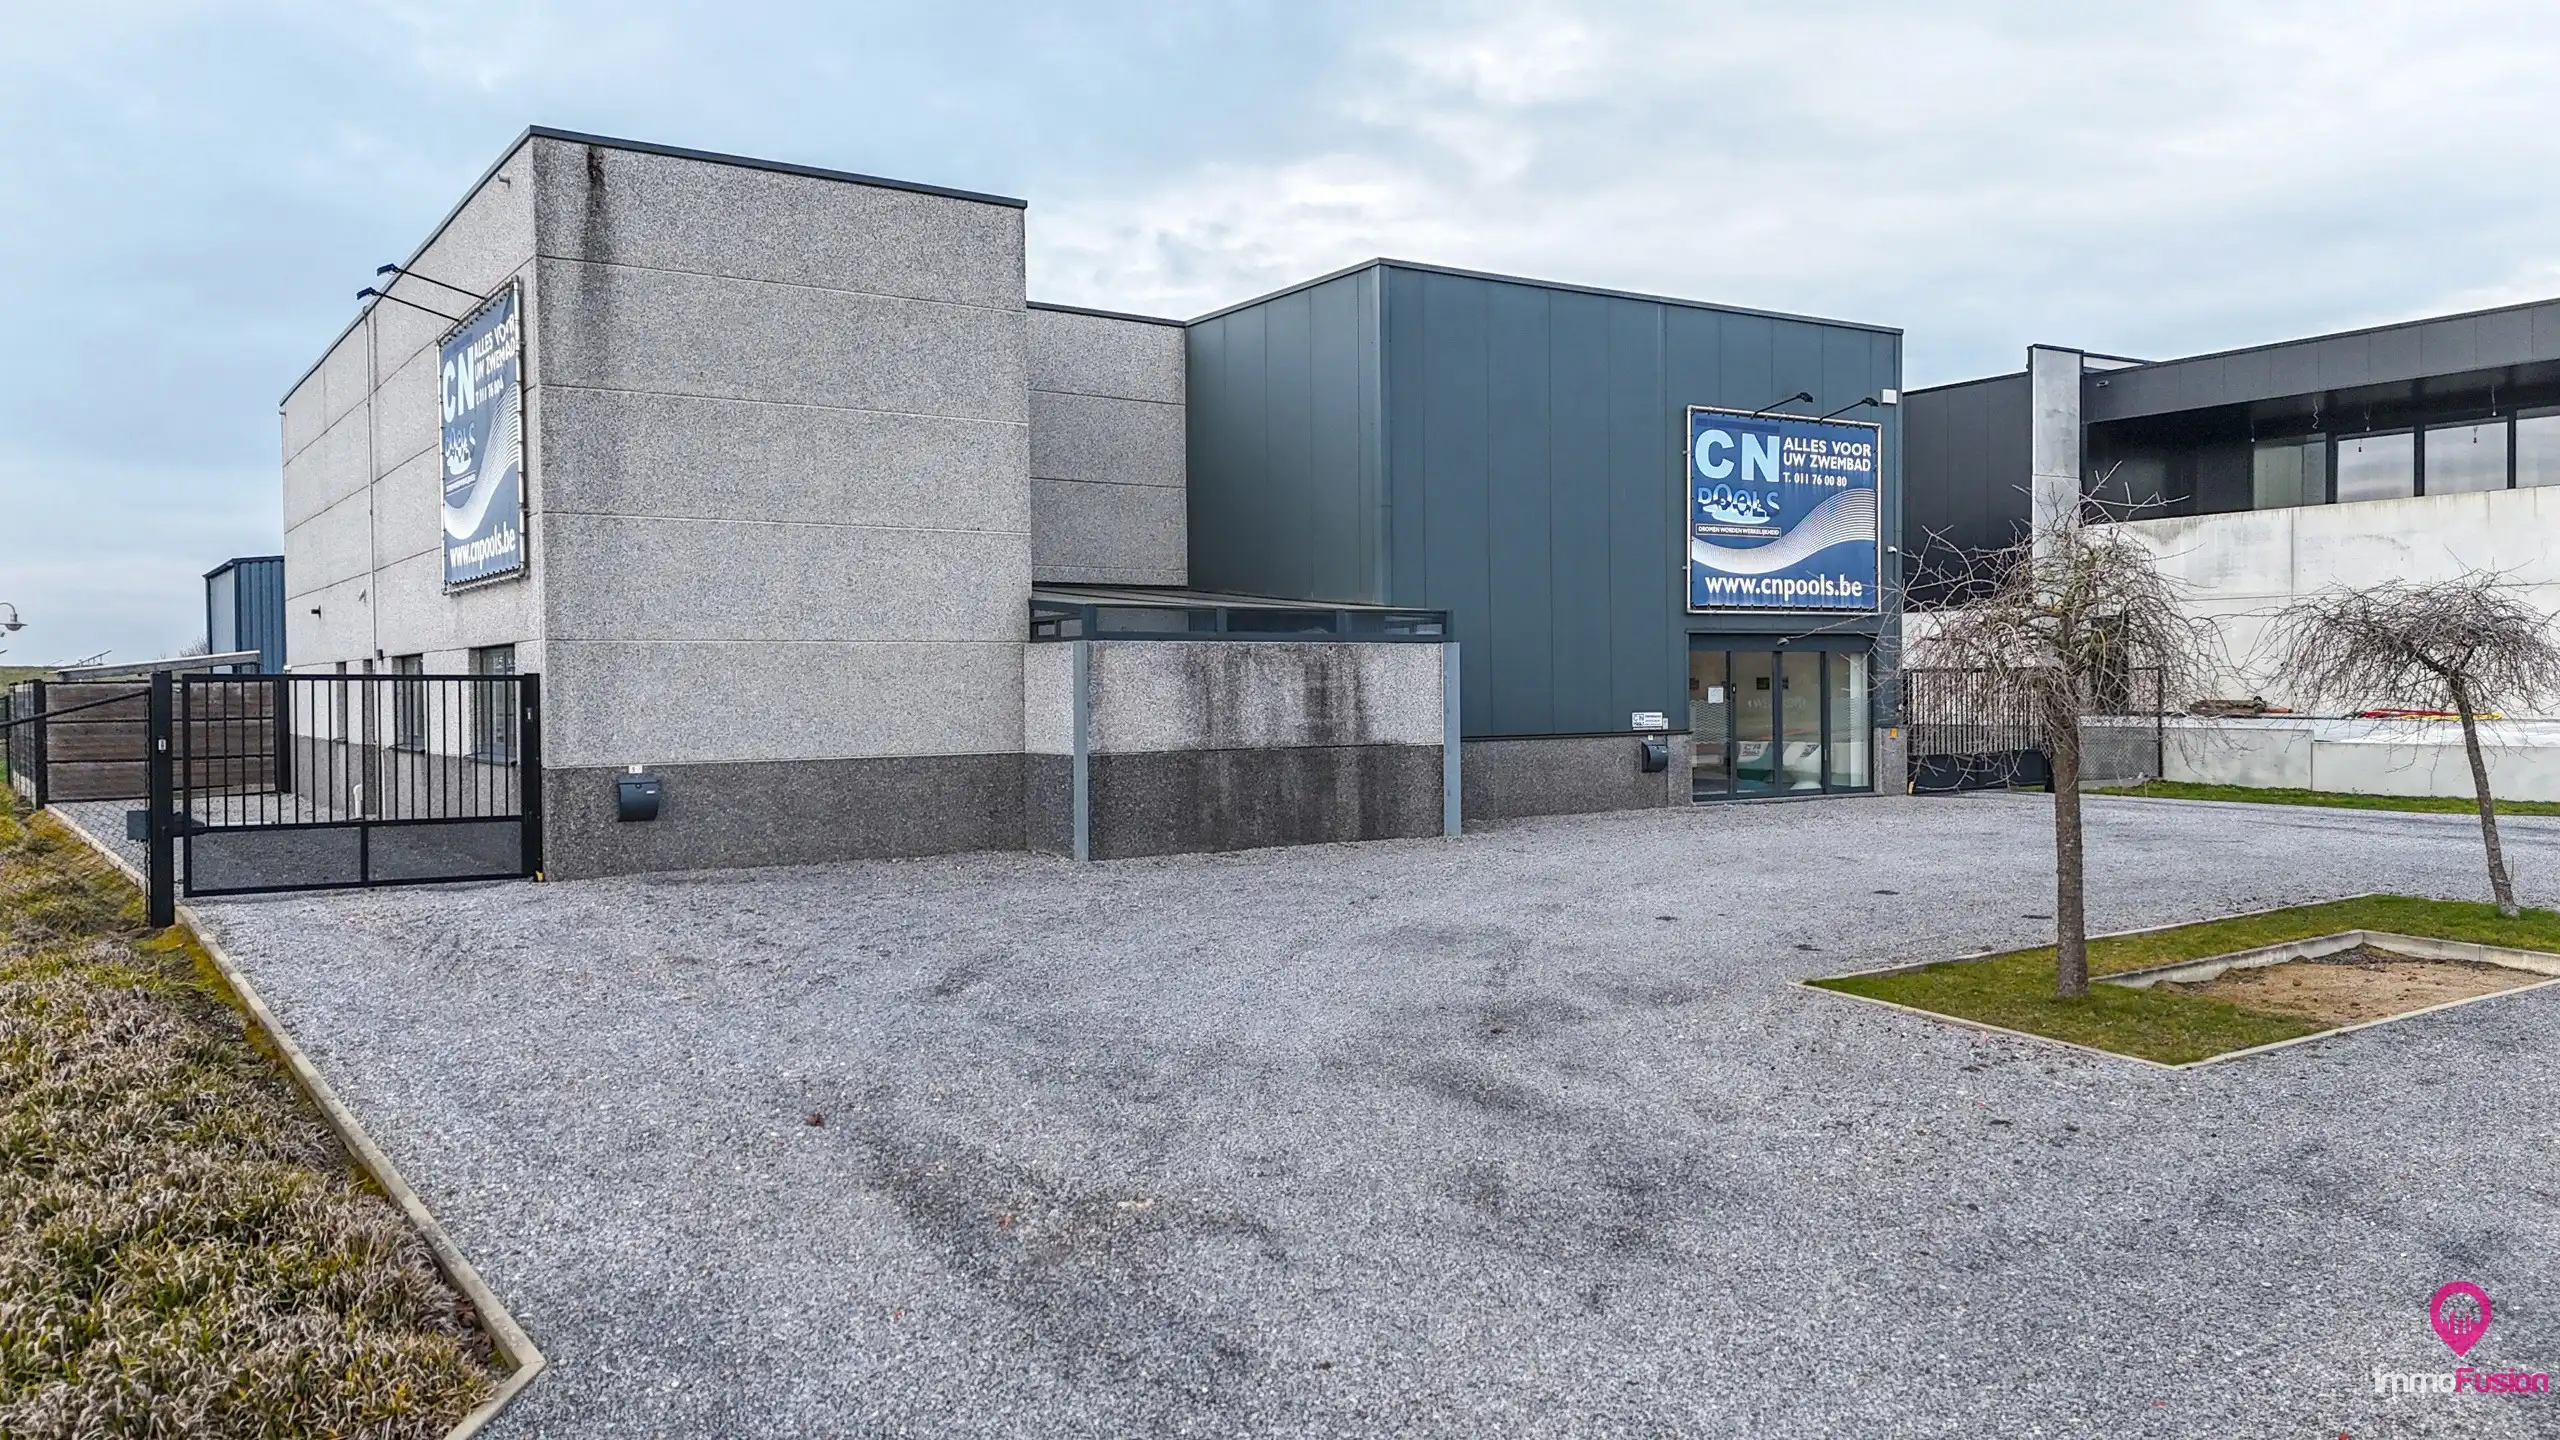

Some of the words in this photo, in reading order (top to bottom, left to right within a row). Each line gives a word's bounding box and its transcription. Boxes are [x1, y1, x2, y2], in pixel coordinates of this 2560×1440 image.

[443, 346, 475, 423] CN
[1695, 429, 1780, 483] CN
[1783, 437, 1827, 453] ALLES
[1831, 441, 1871, 457] VOOR
[1783, 452, 1805, 467] UW
[1809, 455, 1871, 472] ZWEMBAD
[1783, 472, 1791, 483] T.
[1794, 473, 1809, 485] 011
[1812, 474, 1822, 486] 76
[1824, 475, 1835, 486] 00
[1836, 476, 1847, 487] 80
[450, 521, 516, 570] www.cnpools.be
[1705, 574, 1863, 602] www.cnpools.be
